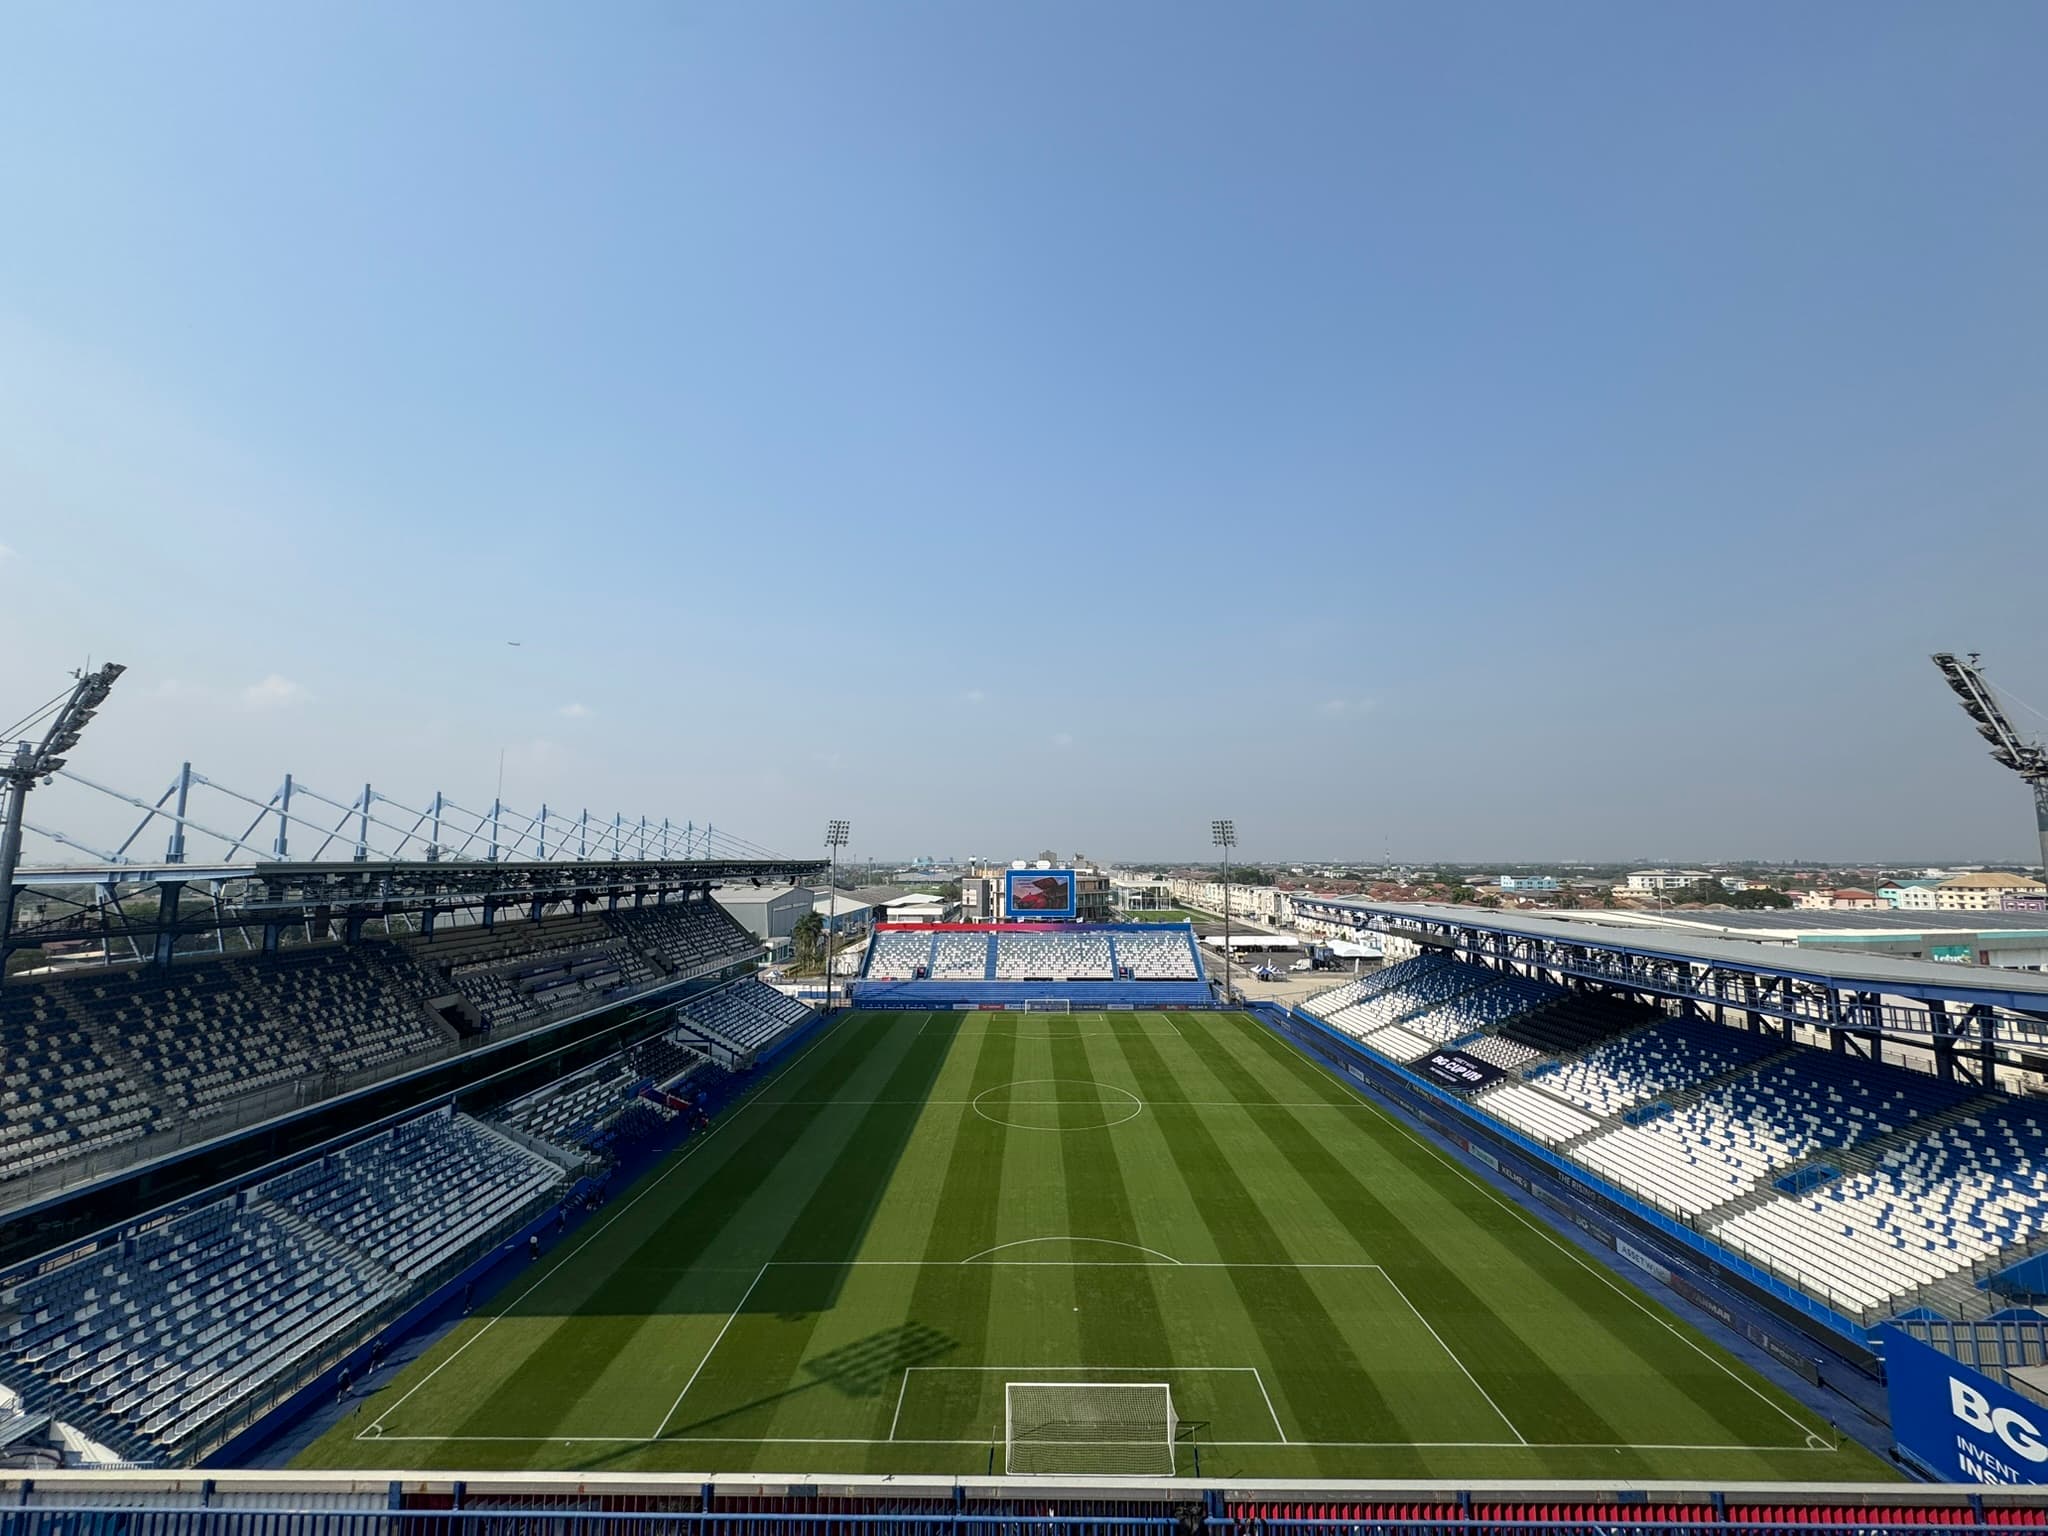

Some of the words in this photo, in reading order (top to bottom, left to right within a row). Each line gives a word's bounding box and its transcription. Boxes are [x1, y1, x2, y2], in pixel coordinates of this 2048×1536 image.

[1431, 1055, 1450, 1066] BG
[1445, 1060, 1467, 1075] CUP
[1462, 1068, 1483, 1082] U19
[1501, 1166, 1524, 1187] KELME
[1558, 1172, 1572, 1187] THE
[1949, 1376, 2048, 1463] BG
[1956, 1435, 2020, 1484] INVENT
